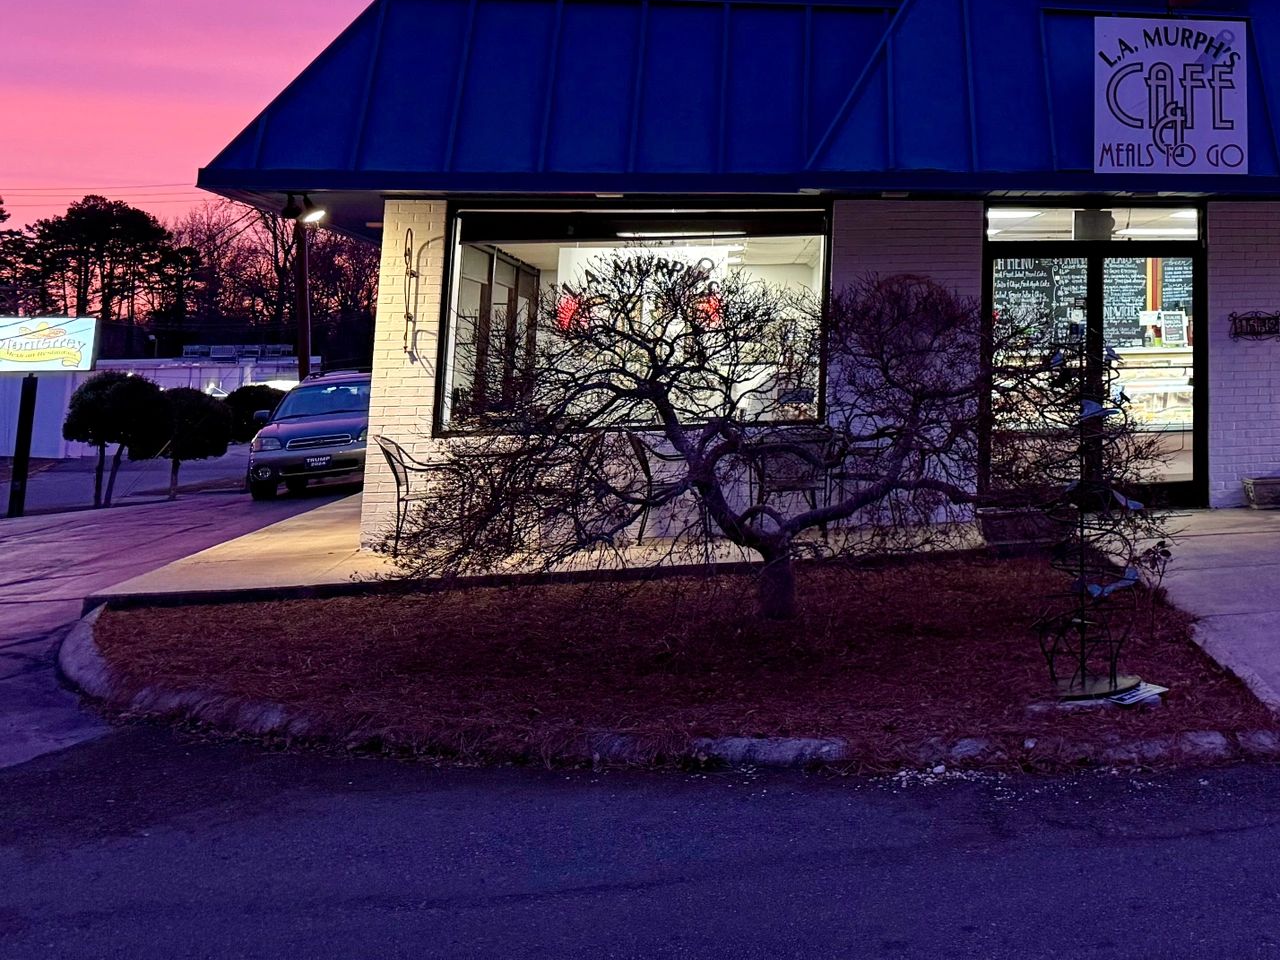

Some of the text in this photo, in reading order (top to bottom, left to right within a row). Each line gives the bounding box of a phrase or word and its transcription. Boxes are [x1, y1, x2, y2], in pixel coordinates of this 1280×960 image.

[1098, 26, 1241, 68] L.A. MURPH'S
[1105, 61, 1235, 131] CAFE
[1099, 143, 1244, 168] MEALS TO GO
